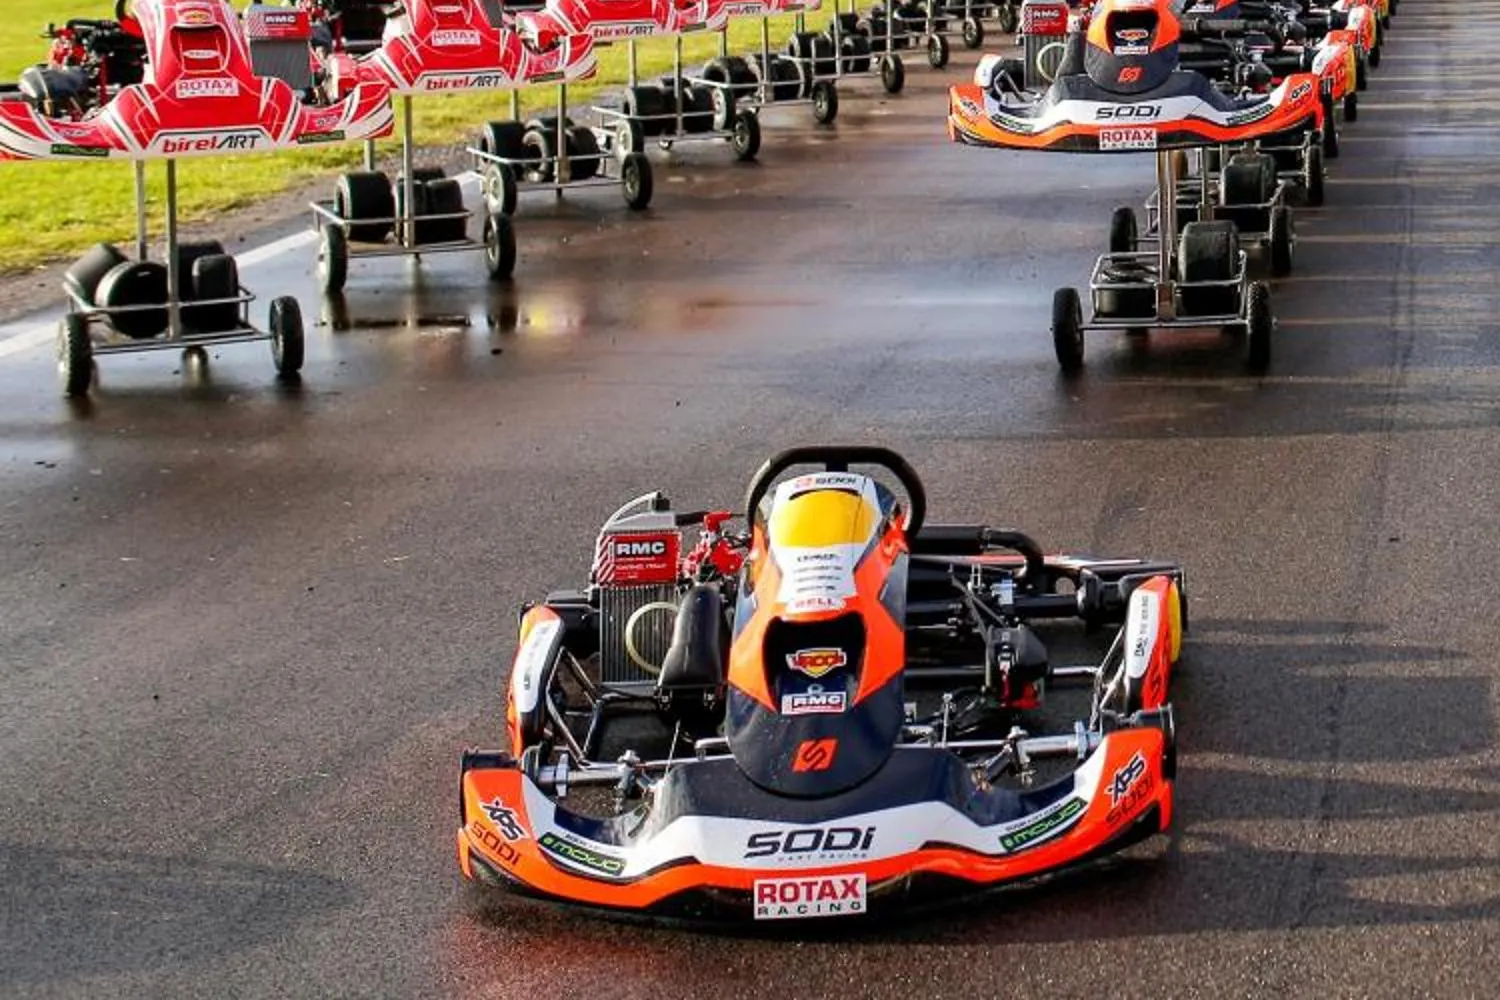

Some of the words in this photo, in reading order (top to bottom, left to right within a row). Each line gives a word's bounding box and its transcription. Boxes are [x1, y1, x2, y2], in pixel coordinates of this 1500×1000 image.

[265, 15, 296, 24] RMC
[433, 31, 479, 42] ROTAX
[179, 78, 234, 90] ROTAX
[425, 73, 502, 91] birelART
[1101, 129, 1154, 142] ROTAX
[163, 133, 261, 153] birelART
[616, 541, 666, 555] RMC
[793, 694, 842, 707] RMC
[757, 877, 861, 904] ROTAX
[757, 901, 862, 916] RACING
